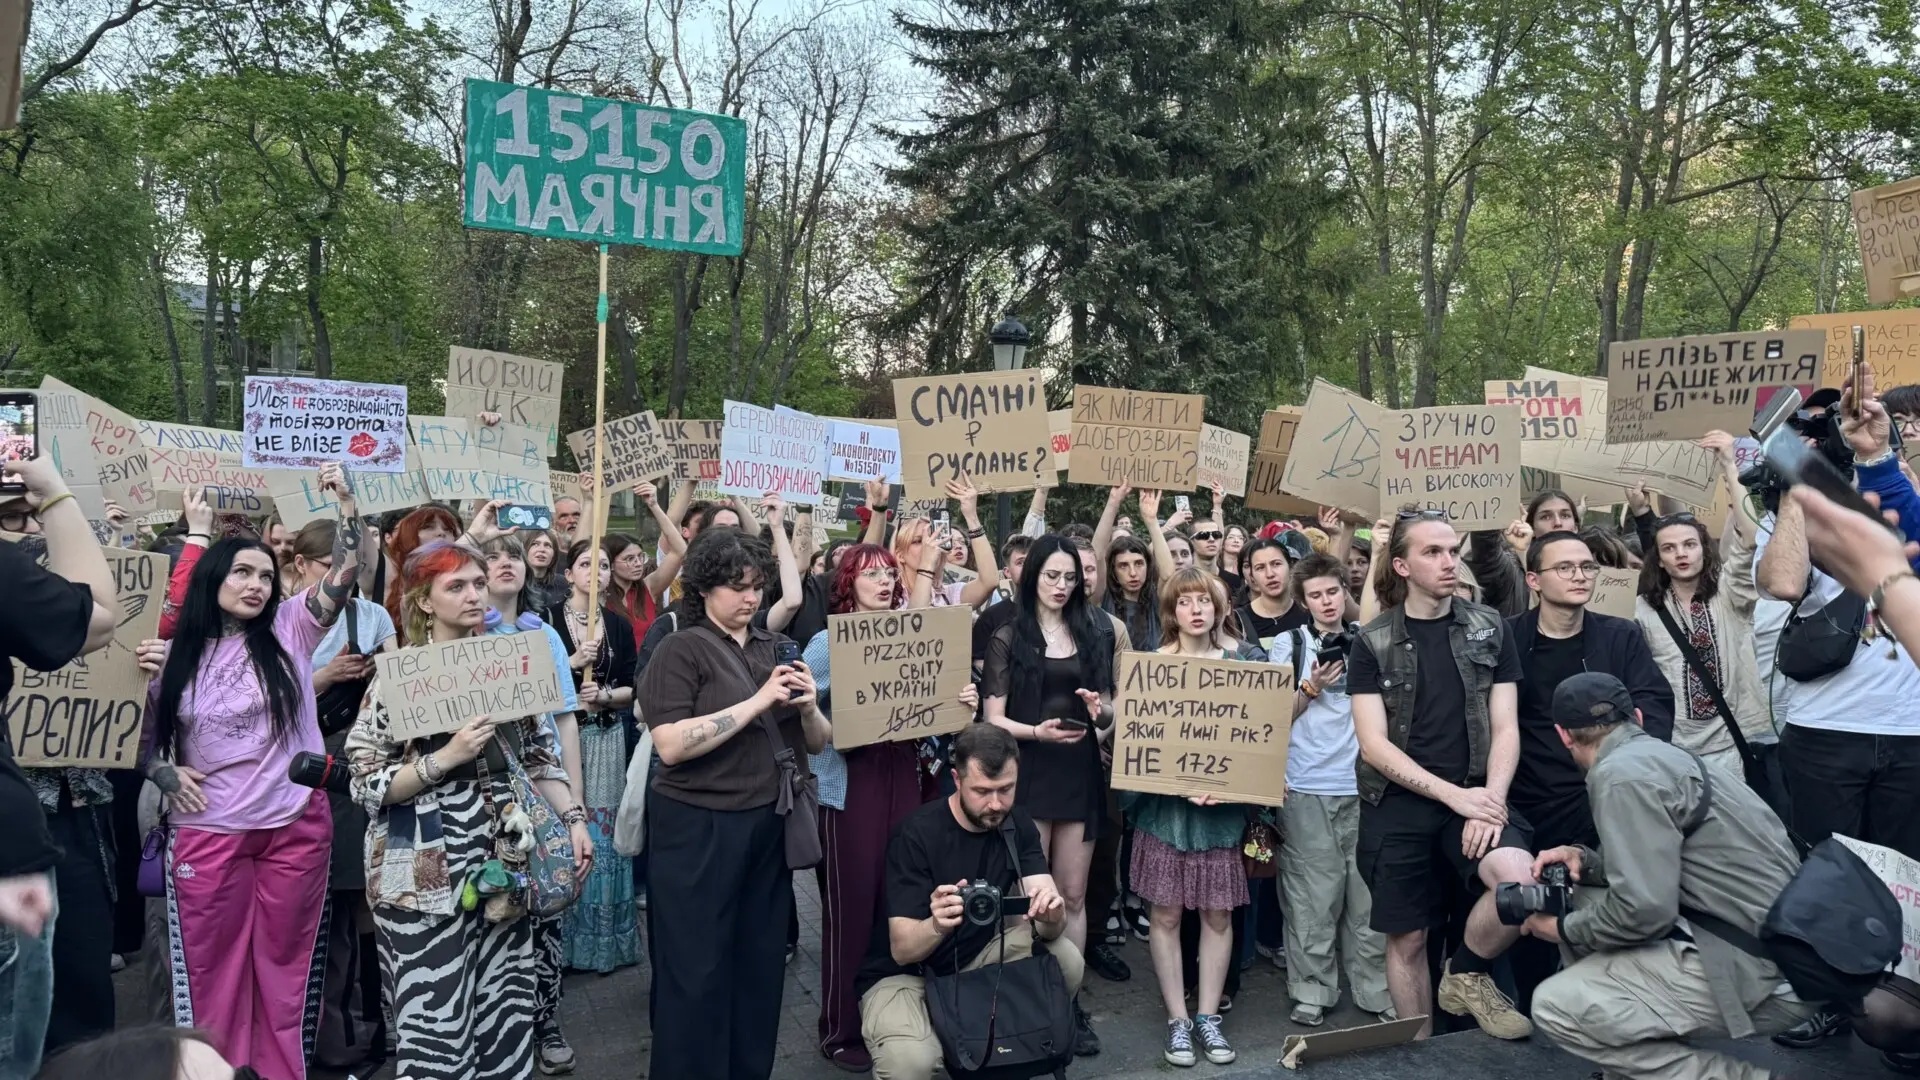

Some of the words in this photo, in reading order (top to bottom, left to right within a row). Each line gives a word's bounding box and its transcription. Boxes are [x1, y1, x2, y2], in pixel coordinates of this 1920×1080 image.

[495, 89, 726, 181] 15150
[472, 162, 727, 244] МАЯЧНЯ
[1622, 348, 1650, 370] НЕ
[1764, 339, 1784, 361] В
[1637, 366, 1721, 393] НАШЕ
[1725, 353, 1818, 384] ЖИТТЯ
[911, 376, 1036, 427] СМАЧНІ
[1507, 380, 1559, 398] МИ
[1077, 392, 1106, 422] ЯК
[1109, 391, 1190, 425] МІРЯТИ
[1488, 397, 1582, 417] ОТИ
[860, 432, 870, 445] НІ
[1209, 429, 1232, 446] ХТО
[1398, 413, 1496, 442] ЗРУЧНО
[255, 434, 284, 452] НЕ
[291, 432, 343, 454] ВЛІЗЕ
[749, 436, 763, 455] ЦЕ
[1395, 442, 1499, 470] ЧЛЕНАМ
[149, 447, 217, 469] ХОЧУ
[1100, 450, 1199, 487] ЧАЙНІСТЬ?
[1204, 456, 1229, 471] МОЮ
[162, 466, 268, 489] ЛЮДСЬКИХ
[549, 473, 578, 484] АГАТО
[724, 460, 822, 495] ДОБРОЗВИЧАЙНО
[1387, 477, 1413, 496] НА
[1426, 473, 1515, 492] ВИСОКОМУ
[204, 485, 261, 511] ПРАВ
[836, 613, 923, 644] НІЯКОГО
[441, 635, 530, 667] ПАТРОН
[899, 659, 944, 682] СВІТУ
[1124, 660, 1189, 694] ЛЮБІ
[1199, 667, 1293, 690] ДЕПУТАТИ
[870, 675, 937, 703] УКРАЇНІ
[1124, 746, 1162, 776] НЕ
[1175, 752, 1233, 776] 1725
